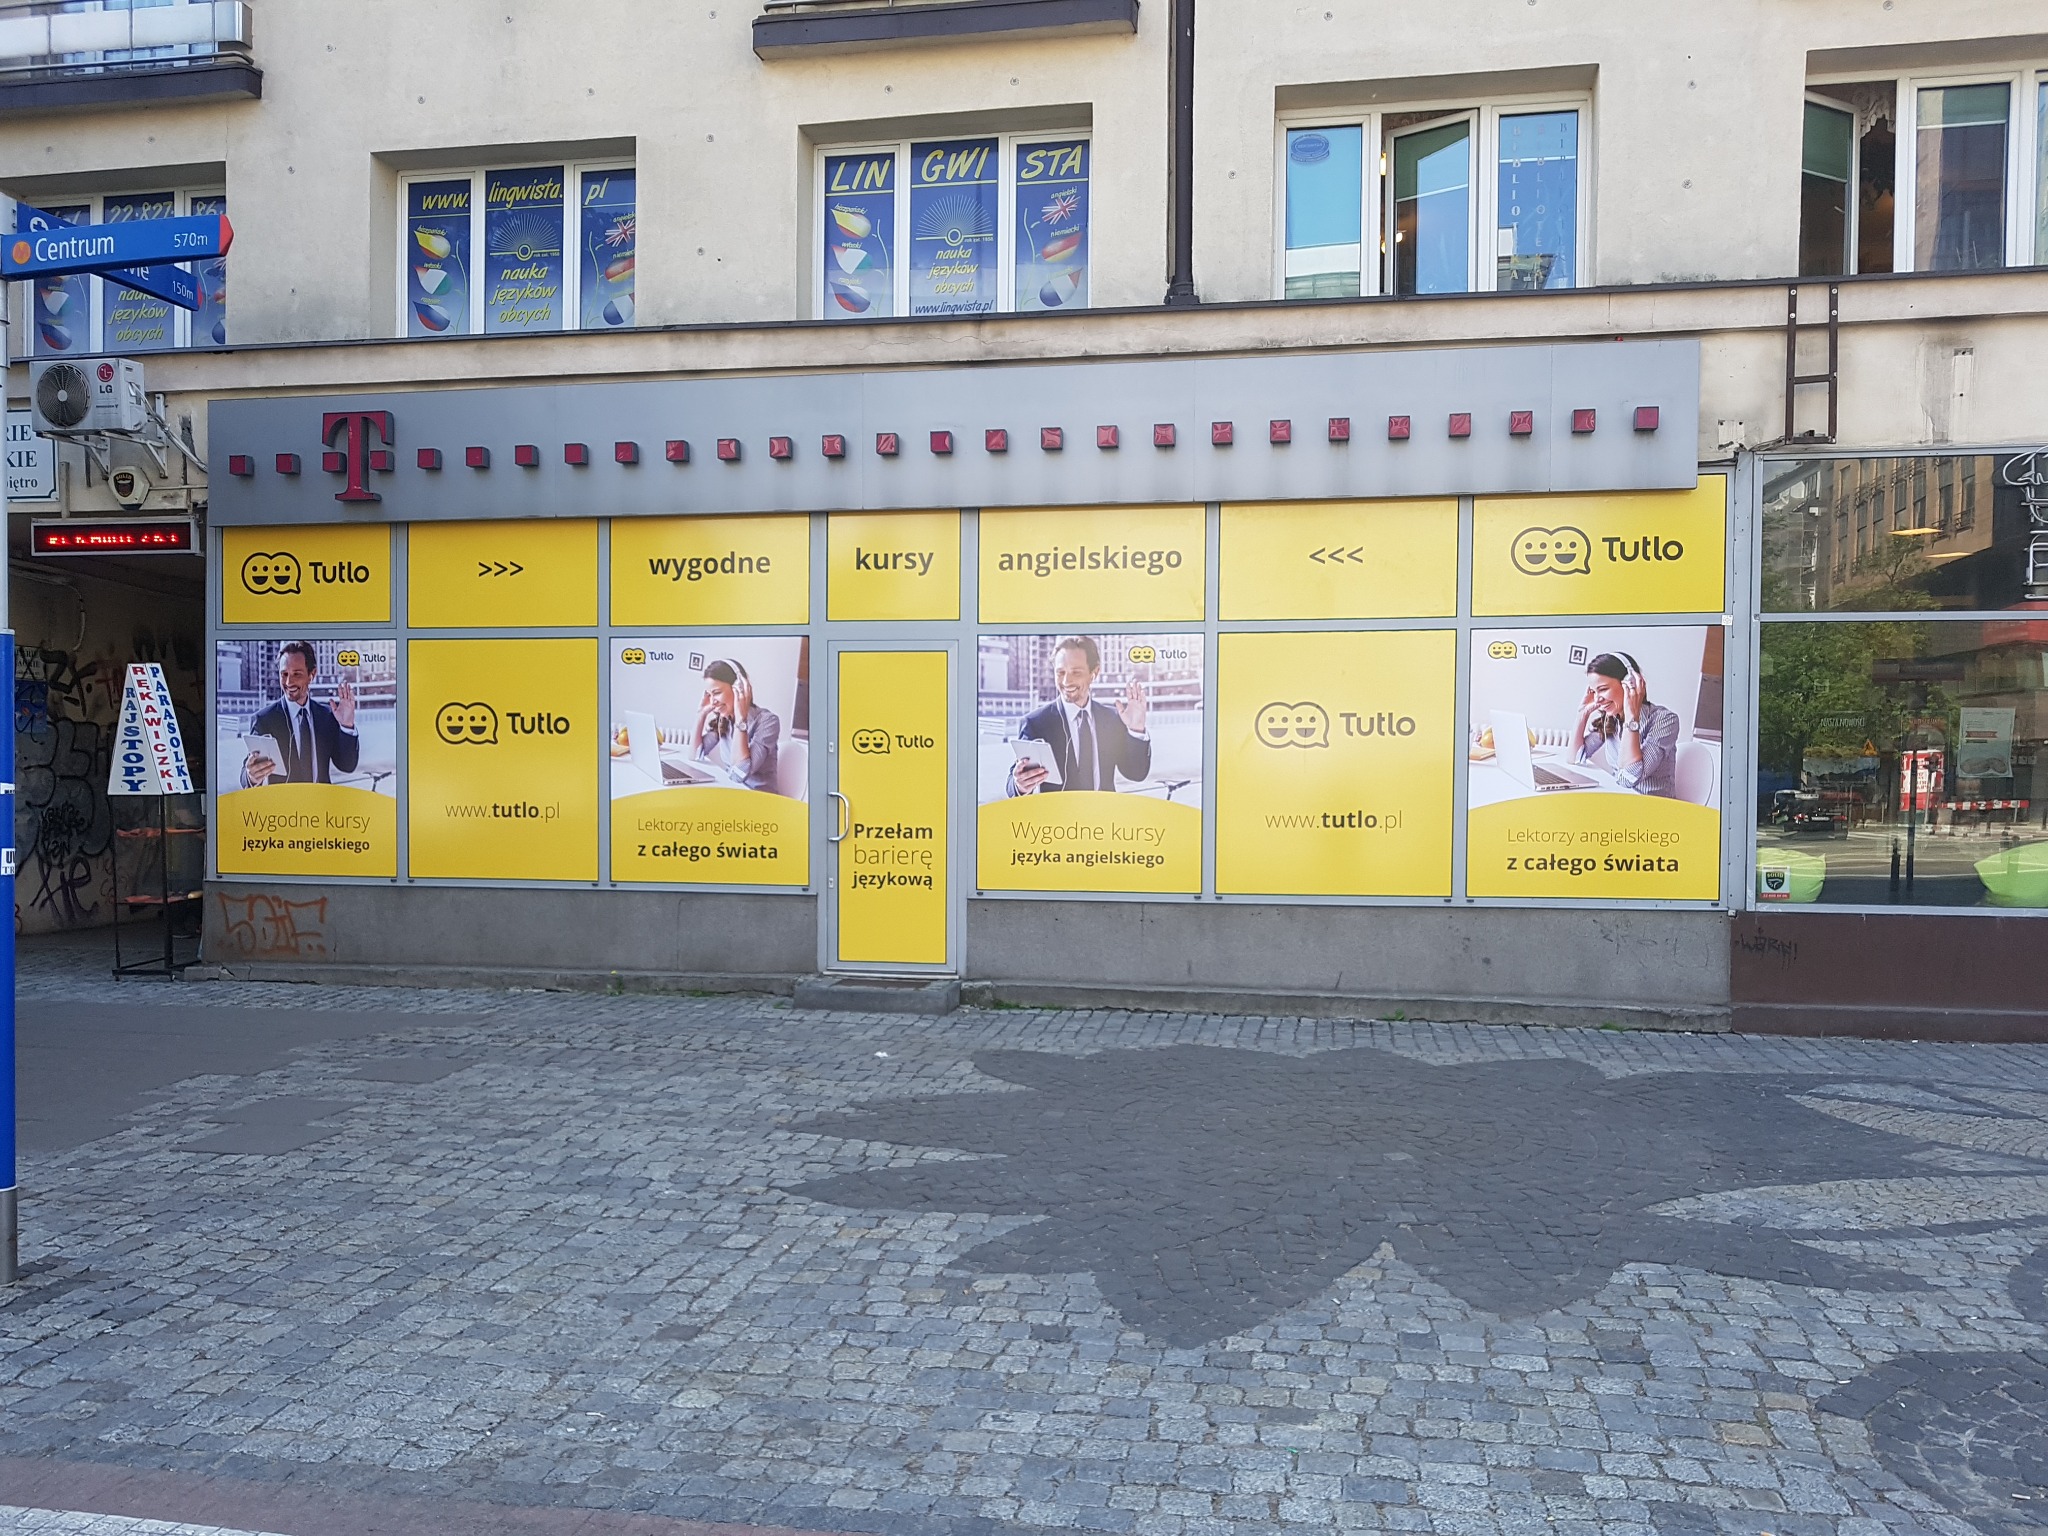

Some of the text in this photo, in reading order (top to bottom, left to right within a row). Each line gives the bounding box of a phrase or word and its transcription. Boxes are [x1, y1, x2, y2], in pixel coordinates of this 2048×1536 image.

[830, 145, 1083, 191] LIN GWI STA
[585, 178, 609, 206] pl
[35, 233, 208, 262] Centrum 570m
[936, 245, 972, 260] nauka
[501, 263, 548, 281] nauka
[926, 261, 979, 280] języków
[172, 280, 194, 301] 150m
[489, 283, 557, 305] języków
[934, 277, 975, 296] obcych
[108, 303, 169, 325] języków
[499, 304, 551, 326] obcych
[914, 298, 995, 316] www.lingwista.pl
[115, 323, 164, 345] obcych
[100, 384, 113, 394] LG
[321, 411, 394, 502] T
[1601, 535, 1684, 562] Tutlo
[308, 560, 370, 585] Tutlo
[648, 545, 1183, 582] wygodne kursy angielskiego
[363, 653, 387, 664] Tutlo
[649, 651, 675, 662] Tutlo
[1159, 649, 1188, 660] Tutlo
[1521, 644, 1552, 655] Tutlo
[150, 666, 189, 791] PARASOLKI
[506, 712, 571, 735] Tutlo
[1339, 712, 1416, 737] Tutlo
[121, 687, 147, 792] RAJSTOPY
[895, 735, 934, 749] Tutlo
[242, 810, 371, 834] Wygodne kursy
[445, 801, 560, 824] www.tutlo.pl
[1265, 809, 1403, 834] www.tutlo.pl
[637, 818, 779, 837] Lektorzy angielskiego
[854, 823, 933, 840] Przełam
[1011, 821, 1166, 847] Wygodne kursy
[1507, 828, 1680, 847] Lektorzy angielskiego
[241, 837, 370, 854] języka angielskiego
[637, 841, 778, 862] z całego świata
[854, 844, 933, 870] barierę
[1011, 849, 1165, 868] języka angielskiego
[1507, 854, 1679, 876] z całego świata
[851, 871, 933, 890] językową
